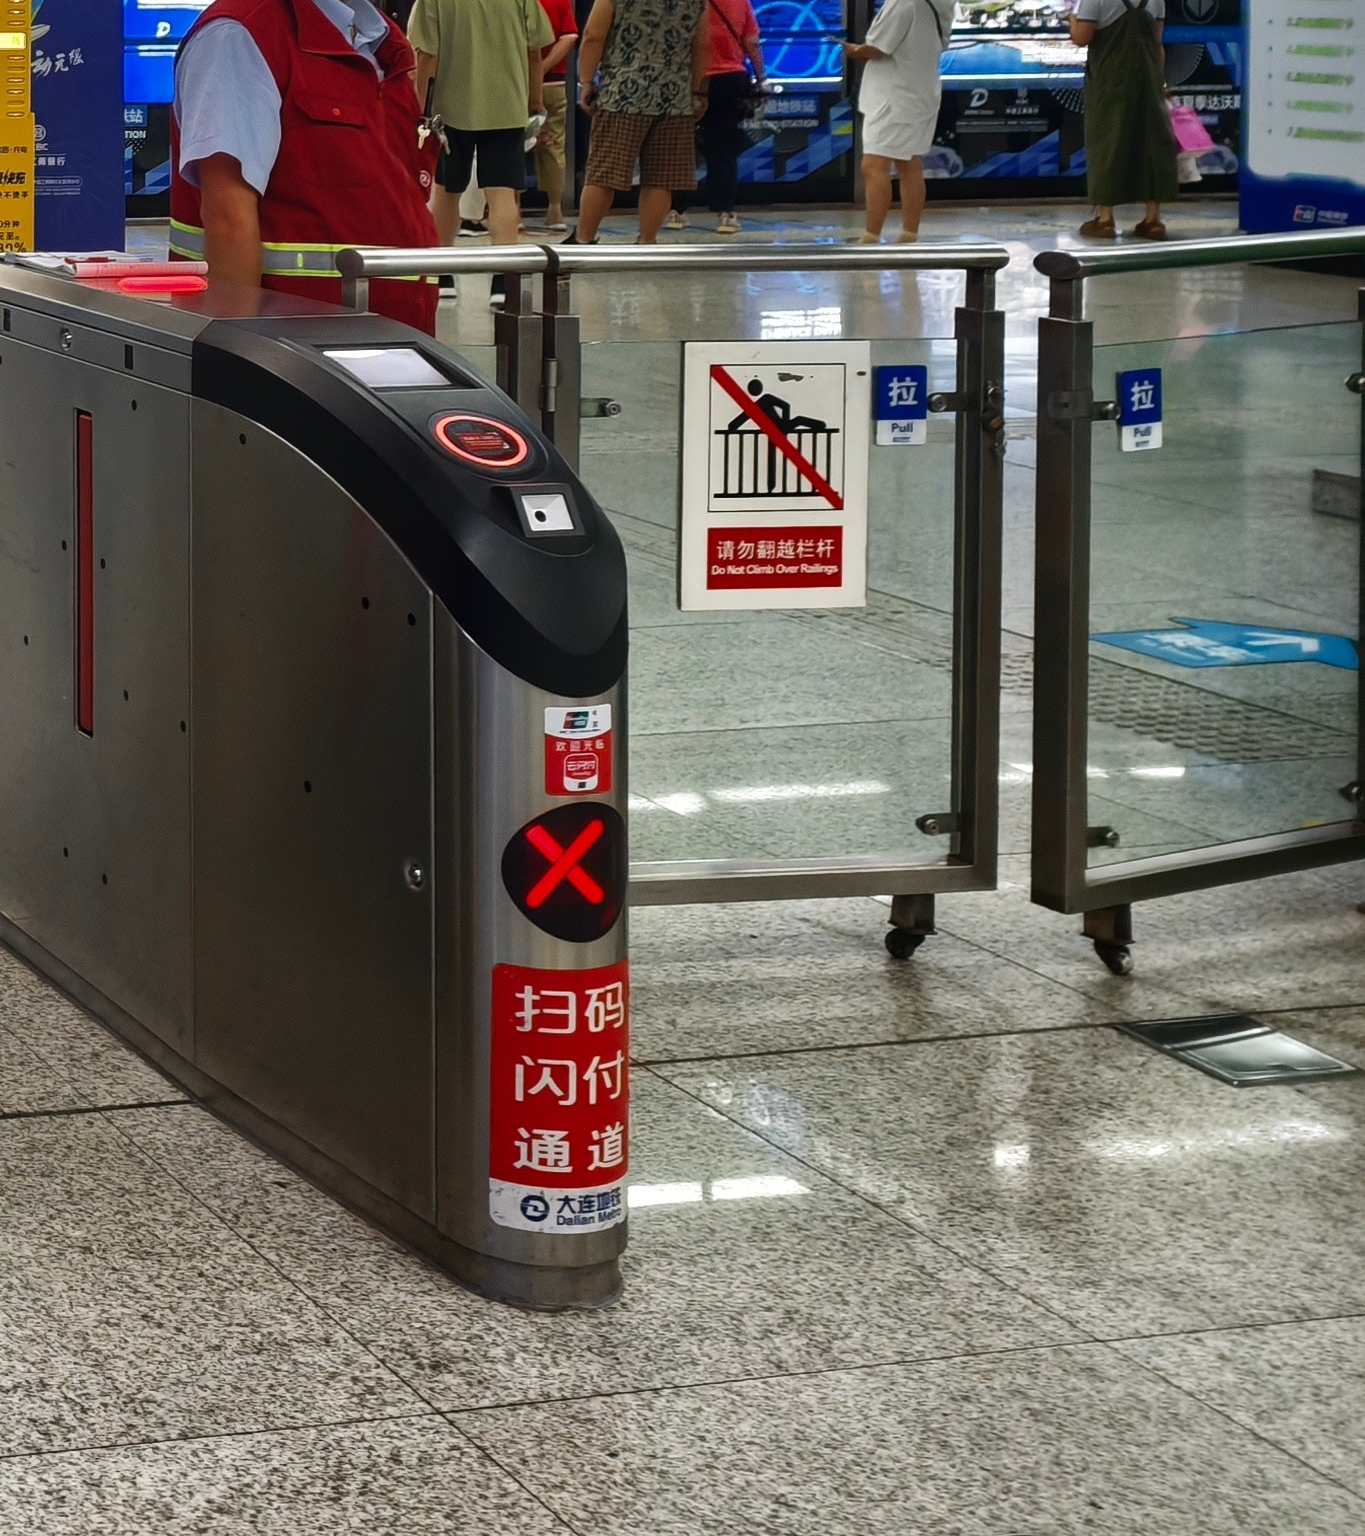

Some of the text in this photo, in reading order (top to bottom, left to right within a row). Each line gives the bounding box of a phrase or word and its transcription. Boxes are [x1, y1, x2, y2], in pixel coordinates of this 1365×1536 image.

[888, 377, 918, 406] 拉
[1131, 381, 1155, 411] 拉
[891, 422, 913, 433] Pull
[716, 539, 835, 560] 请勿翻越栏杆
[711, 565, 726, 575] Do
[727, 565, 745, 575] Not
[746, 564, 774, 574] Climb
[776, 563, 799, 574] Over
[515, 981, 624, 1034] 扫码
[514, 1055, 625, 1105] 闪付
[513, 1123, 625, 1172] 通道
[556, 1186, 623, 1215] 大连地铁
